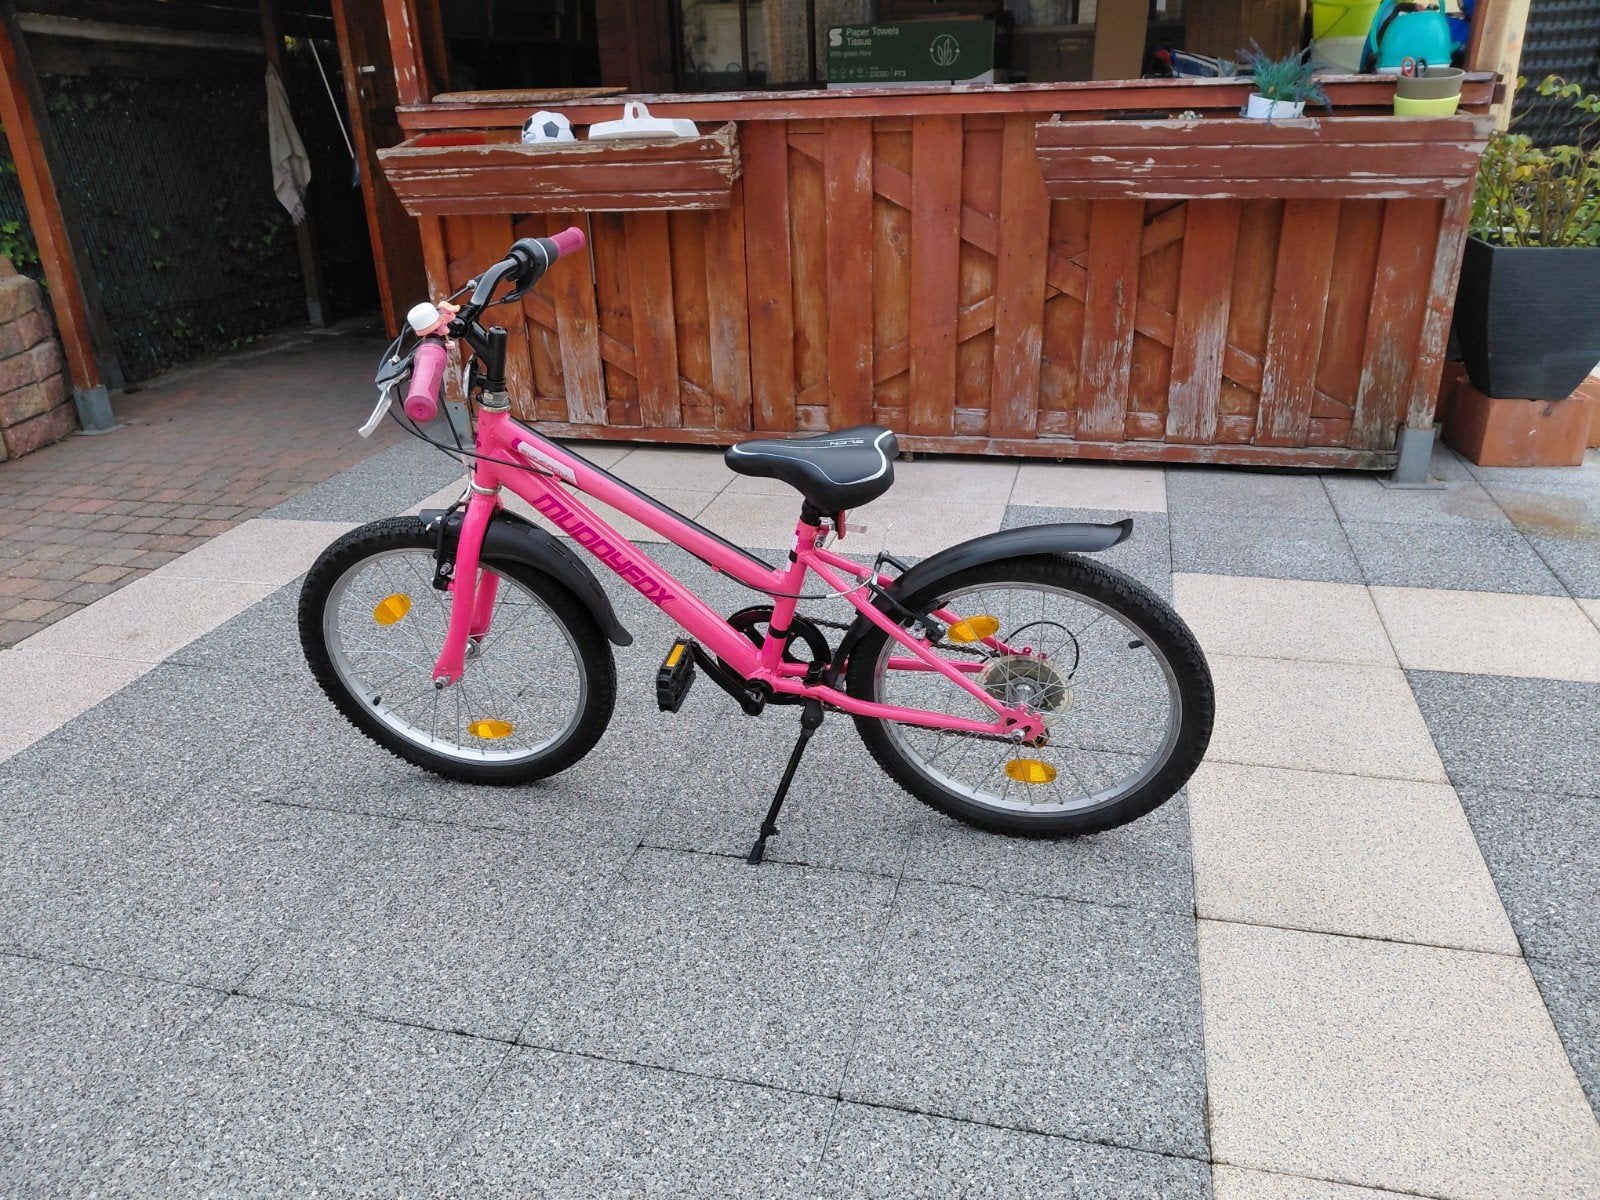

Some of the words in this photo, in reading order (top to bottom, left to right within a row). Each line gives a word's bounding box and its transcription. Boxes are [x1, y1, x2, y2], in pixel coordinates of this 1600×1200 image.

[846, 27, 869, 38] Paper
[871, 26, 900, 35] Towels
[846, 37, 872, 46] Tissue
[531, 493, 678, 607] MUDDYFOX
